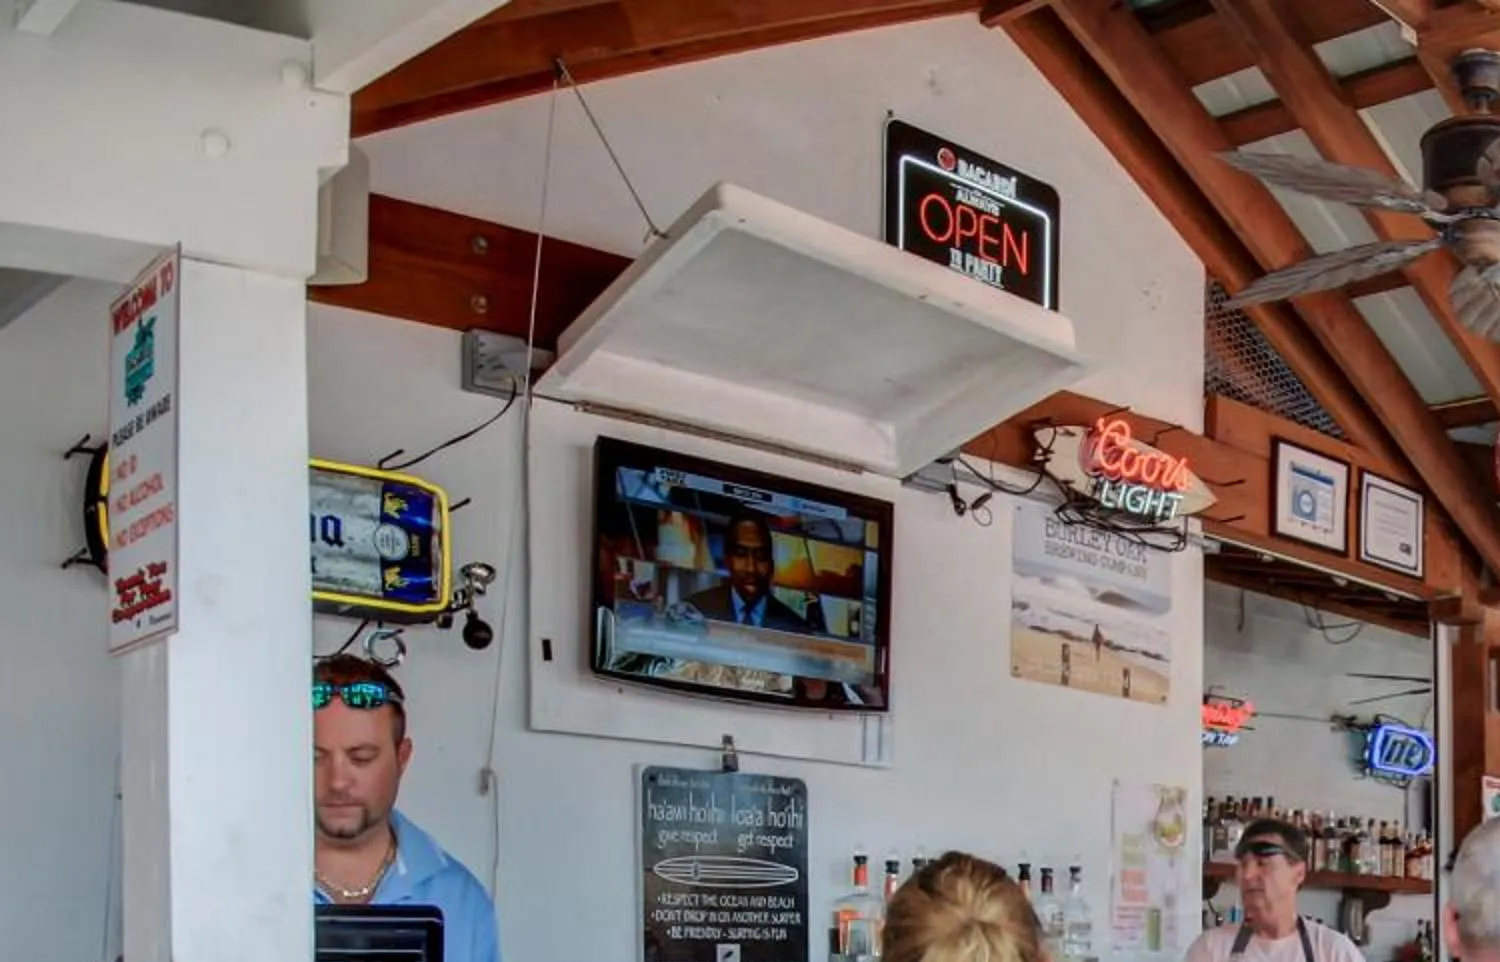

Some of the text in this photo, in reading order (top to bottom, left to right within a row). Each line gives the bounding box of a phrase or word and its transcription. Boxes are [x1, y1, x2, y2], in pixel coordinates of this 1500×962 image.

[919, 193, 1028, 276] OPEN
[159, 259, 175, 298] TO
[965, 253, 1004, 284] PARTY
[1095, 417, 1193, 491] Coors
[1100, 481, 1185, 520] LIGHT
[1045, 516, 1112, 553] BURLEY
[657, 828, 718, 852] give respect
[737, 831, 794, 856] get respect
[720, 895, 749, 907] OCEAN
[768, 896, 796, 909] BEACH
